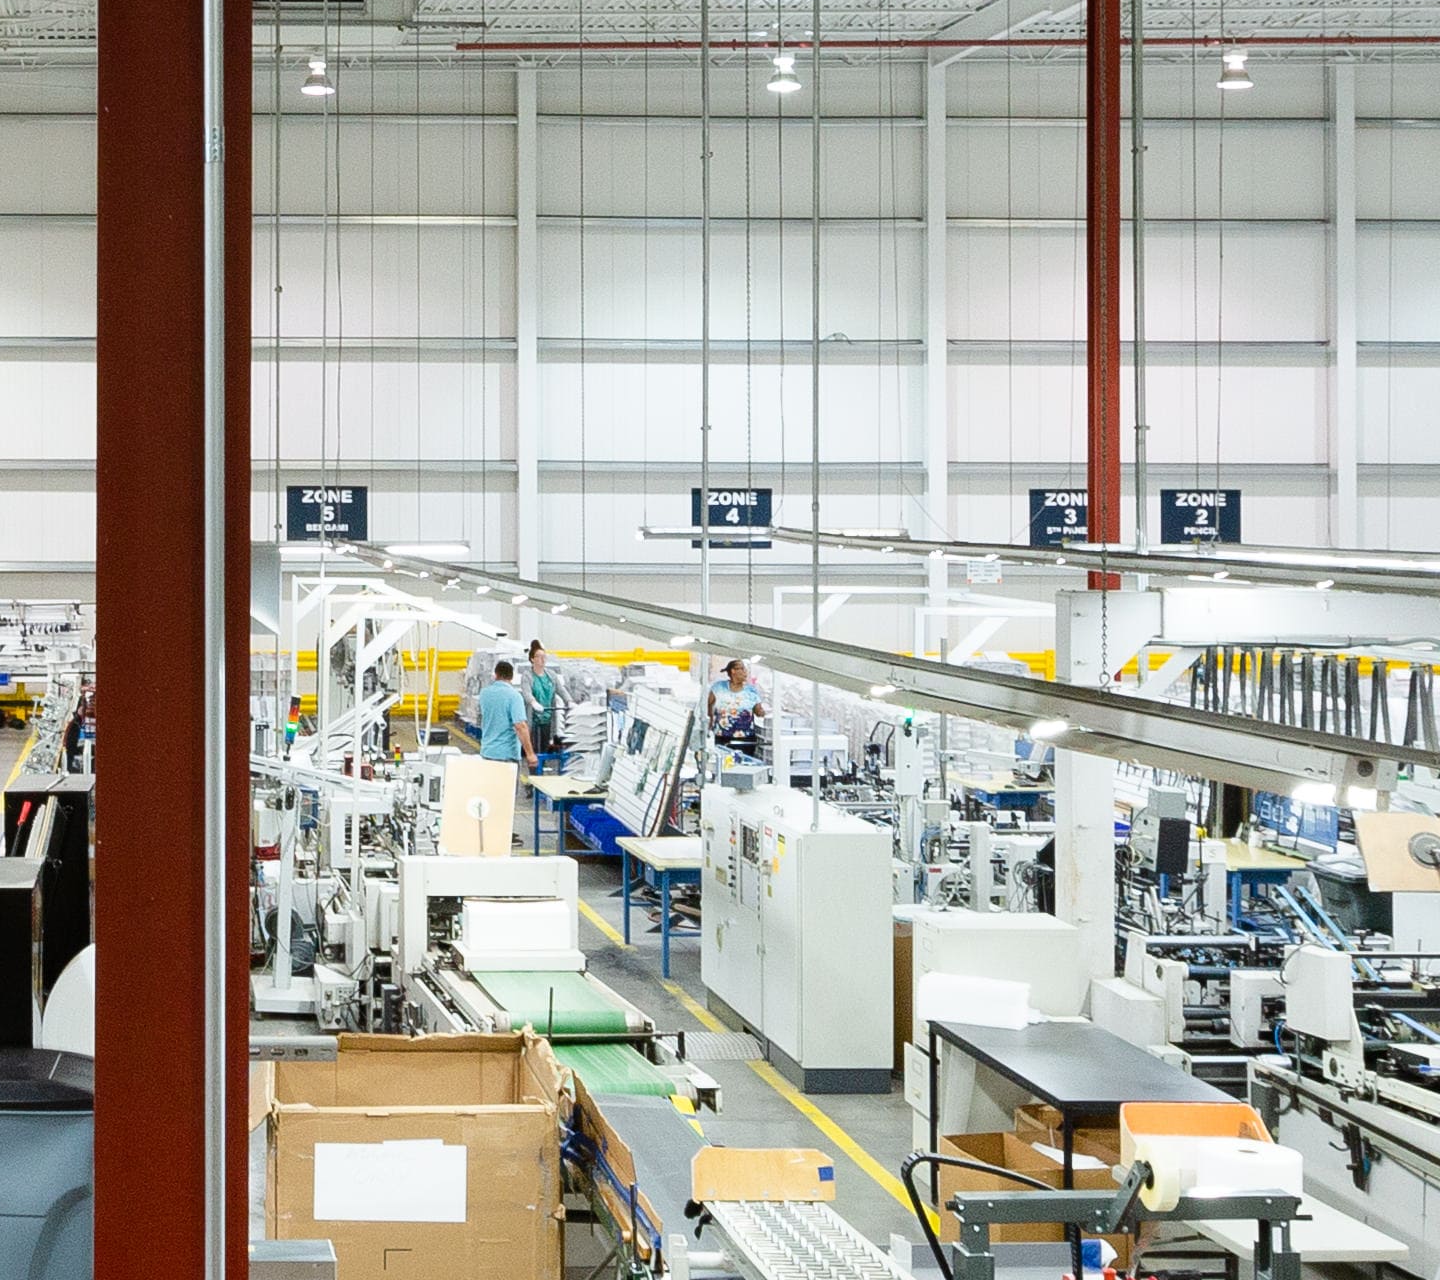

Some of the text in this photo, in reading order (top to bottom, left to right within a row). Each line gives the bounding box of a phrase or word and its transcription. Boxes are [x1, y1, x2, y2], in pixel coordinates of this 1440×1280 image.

[301, 489, 353, 504] ZONE
[707, 492, 758, 506] ZONE
[1175, 493, 1227, 507] ZONE
[322, 505, 335, 522] 5
[725, 507, 740, 524] 4
[1064, 508, 1078, 525] 3
[1195, 508, 1209, 525] 2
[1063, 526, 1088, 535] PANE
[1183, 526, 1219, 535] PENCIL
